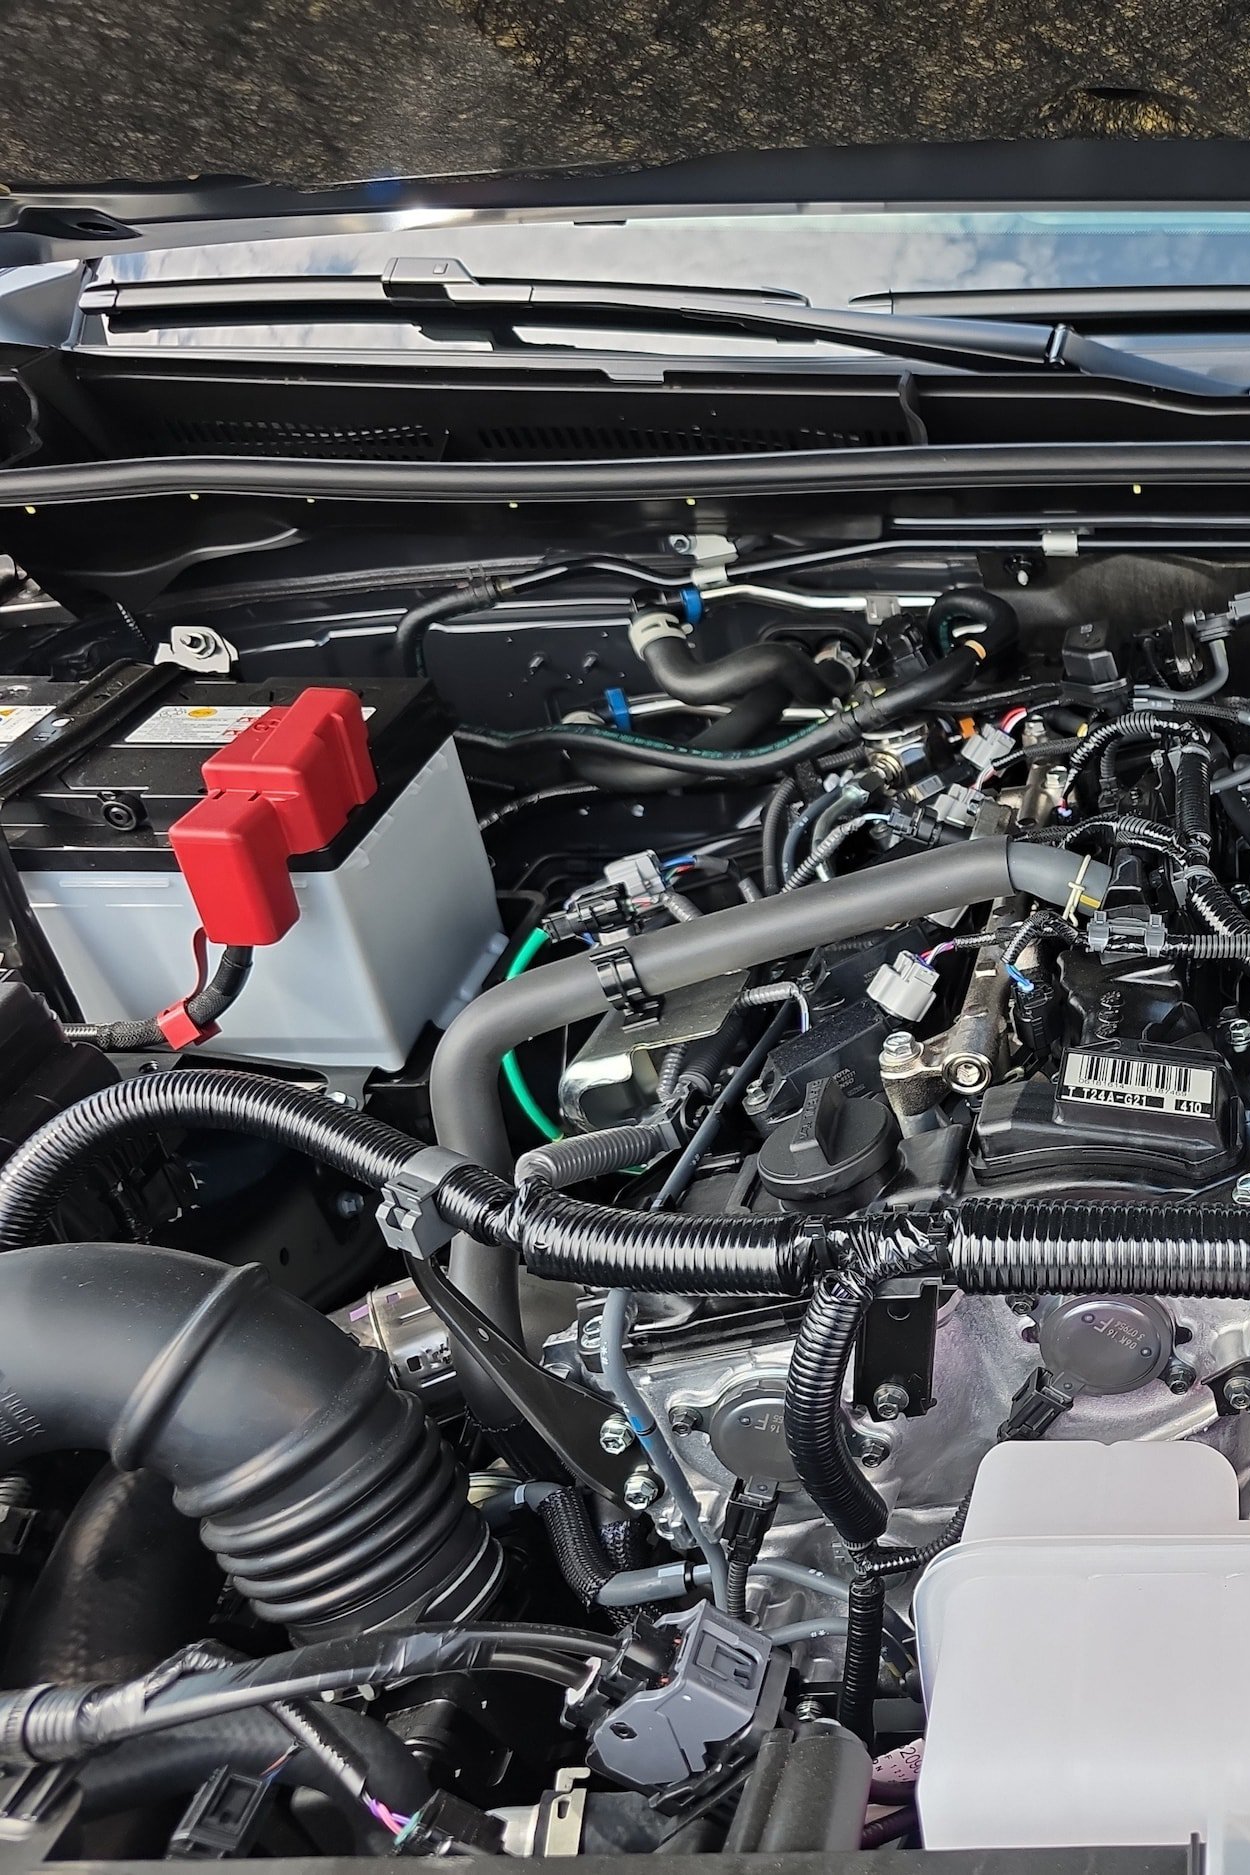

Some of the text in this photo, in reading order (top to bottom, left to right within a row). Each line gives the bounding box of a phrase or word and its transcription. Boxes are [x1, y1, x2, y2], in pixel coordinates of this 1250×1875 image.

[1068, 1086, 1202, 1113] T T24A-G21 410
[1093, 1317, 1114, 1333] F
[1106, 1329, 1138, 1350] 06K 16
[754, 1413, 770, 1431] F
